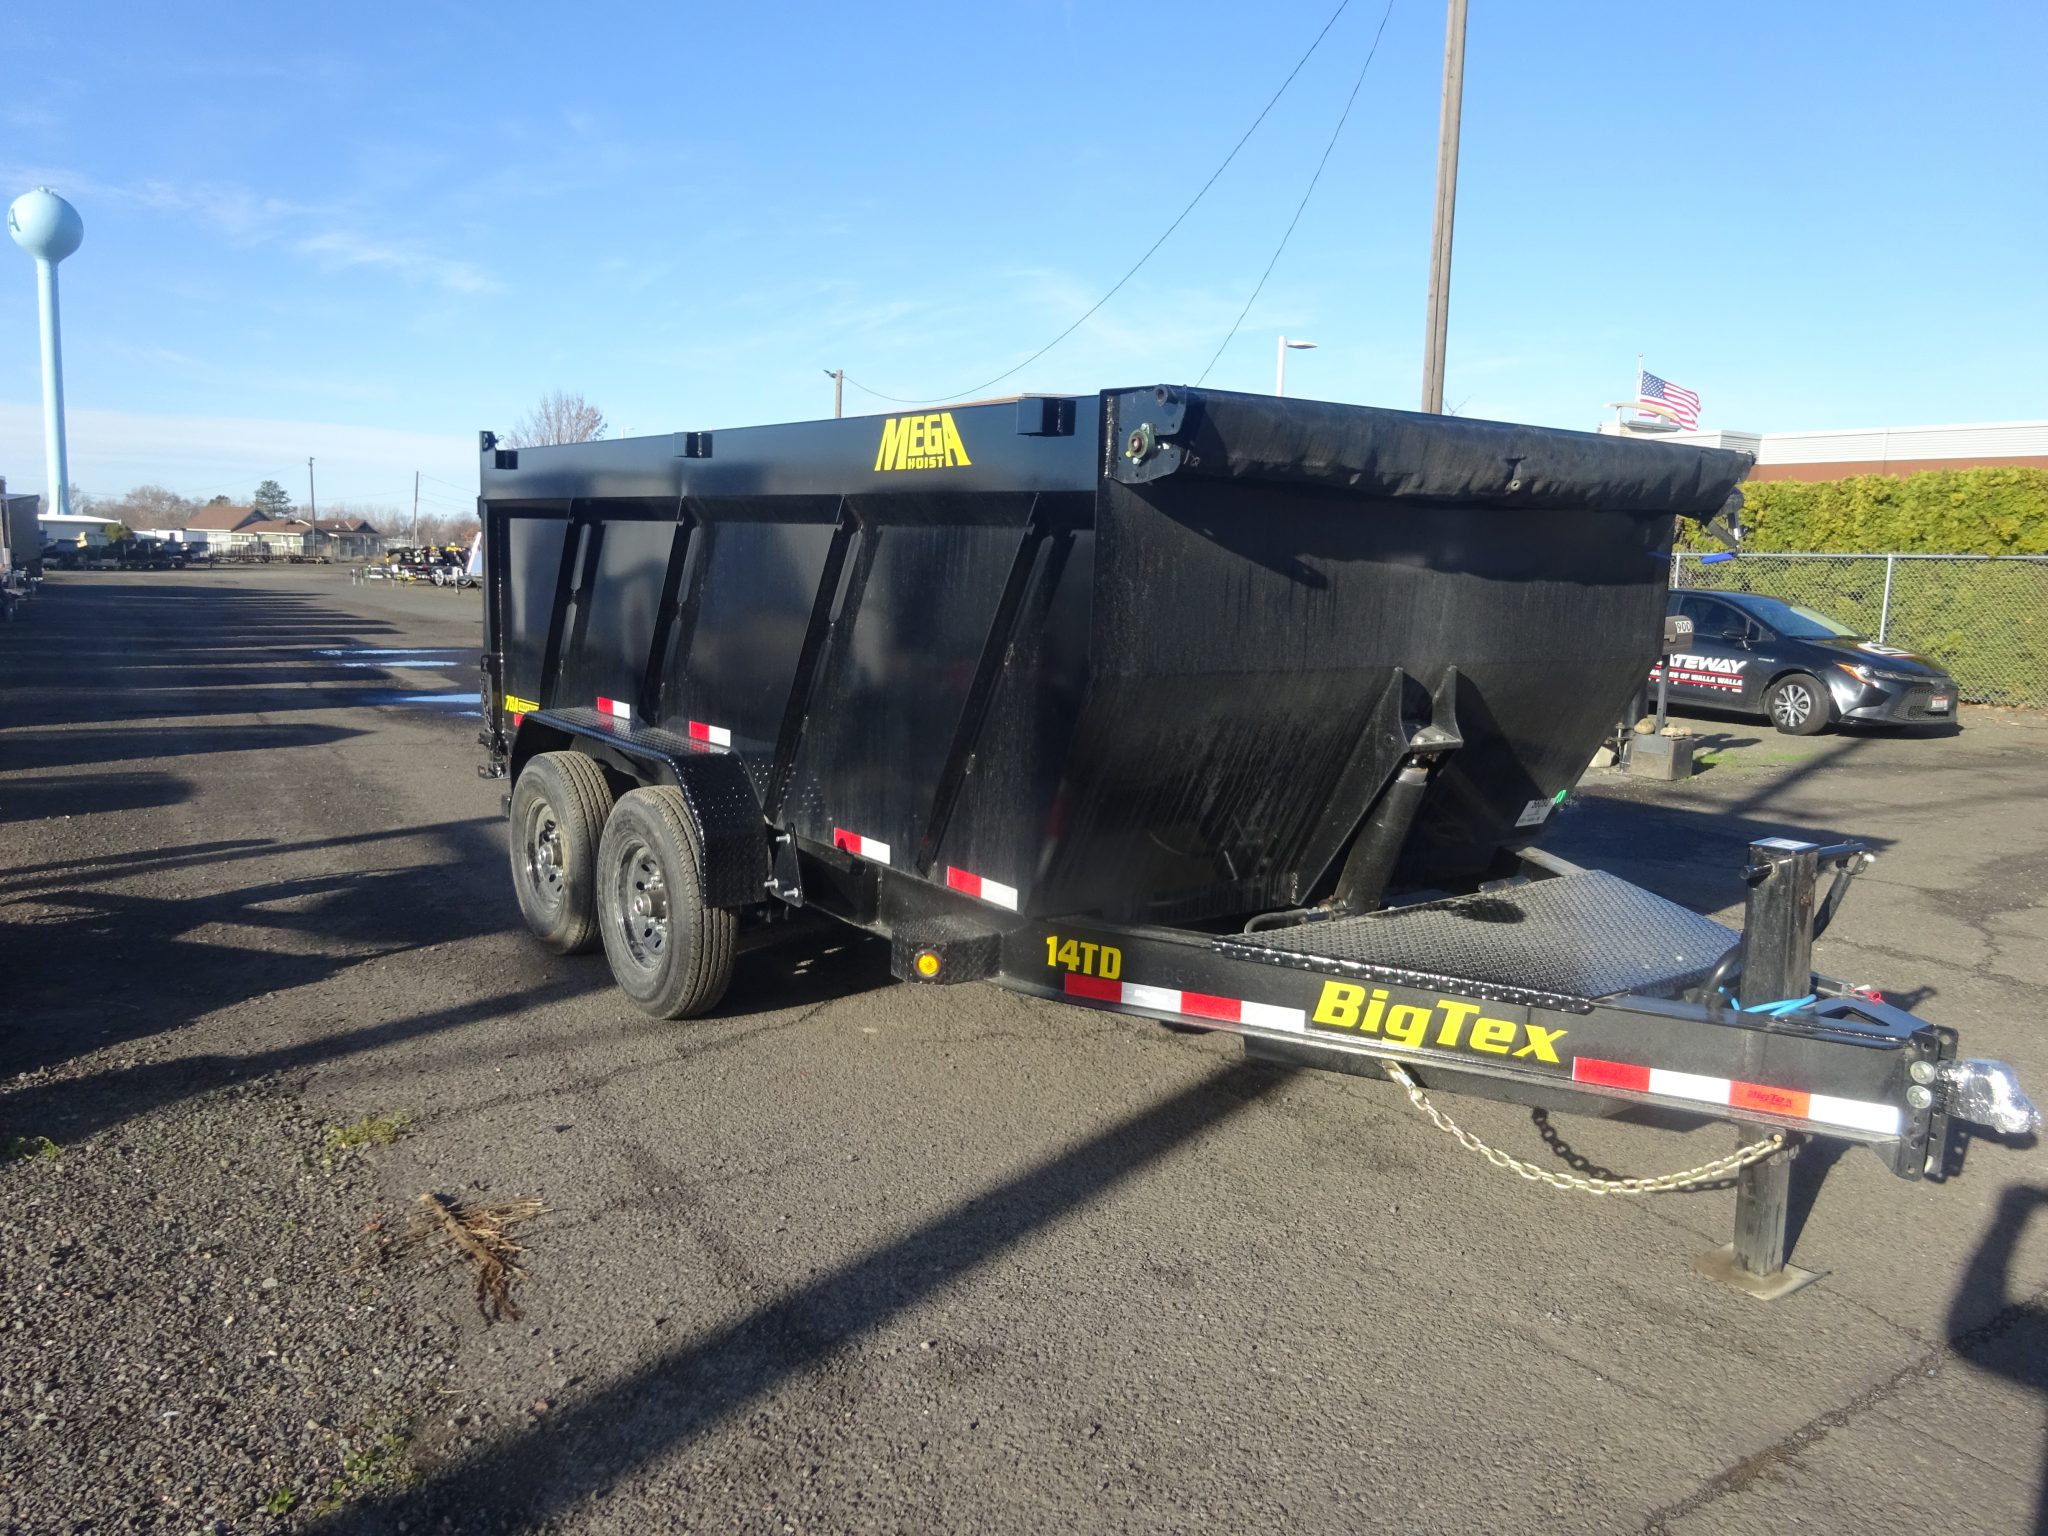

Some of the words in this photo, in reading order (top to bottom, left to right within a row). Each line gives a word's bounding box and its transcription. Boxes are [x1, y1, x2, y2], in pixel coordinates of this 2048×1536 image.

[874, 412, 972, 471] MEGA
[907, 455, 944, 470] HOIST
[1656, 653, 1748, 674] ATEWAY
[1680, 672, 1690, 680] OF
[1690, 674, 1716, 683] WALLA
[1717, 677, 1743, 686] WALLA
[1046, 935, 1121, 980] 14TD
[1312, 980, 1568, 1063] BigTex
